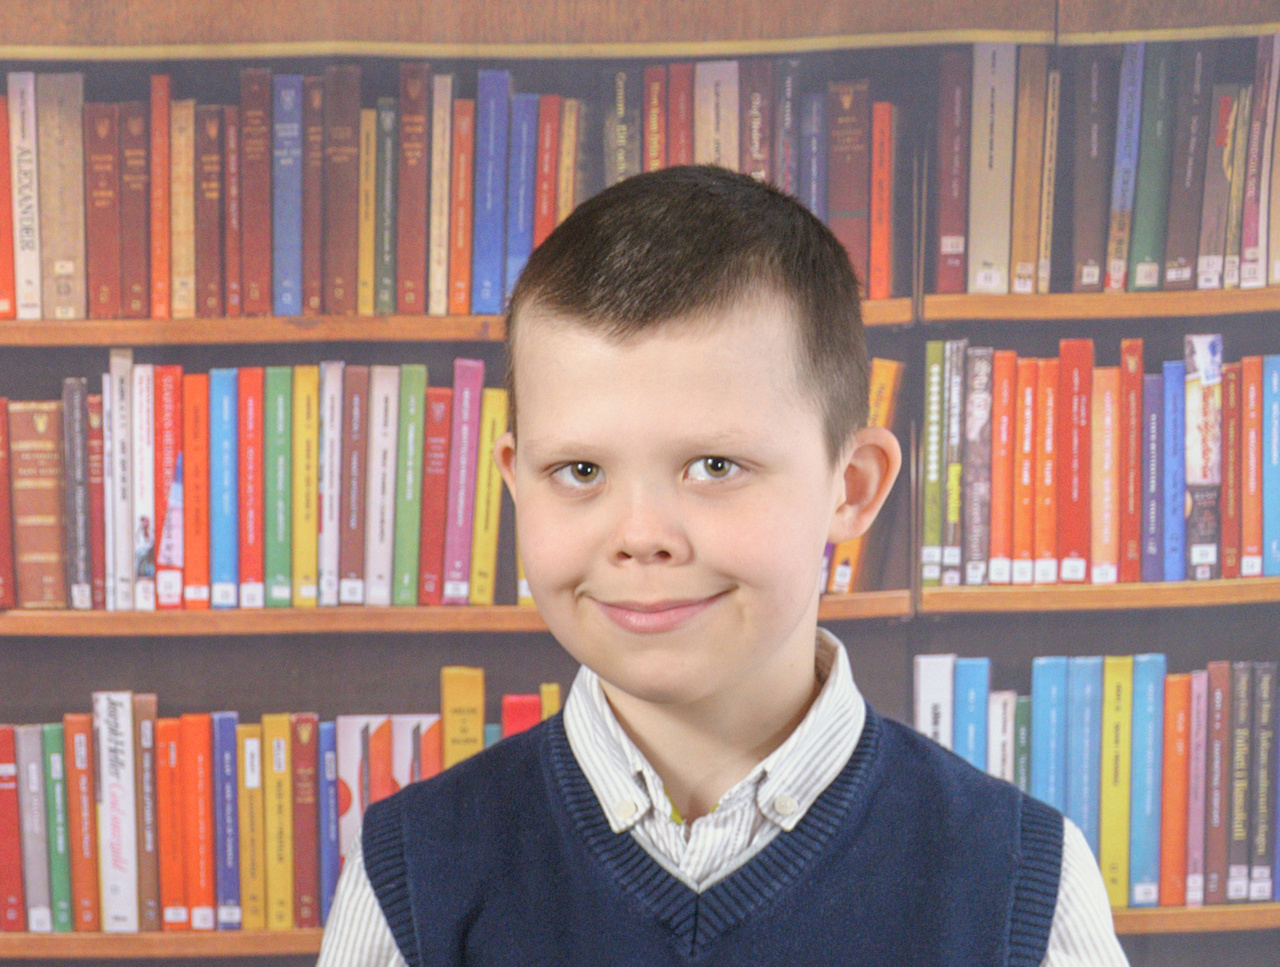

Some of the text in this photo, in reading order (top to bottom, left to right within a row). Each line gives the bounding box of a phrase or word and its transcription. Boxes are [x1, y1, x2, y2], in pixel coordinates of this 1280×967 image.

[17, 146, 35, 251] ALEXANDER
[104, 696, 124, 737] Joseph
[109, 731, 125, 779] Heller
